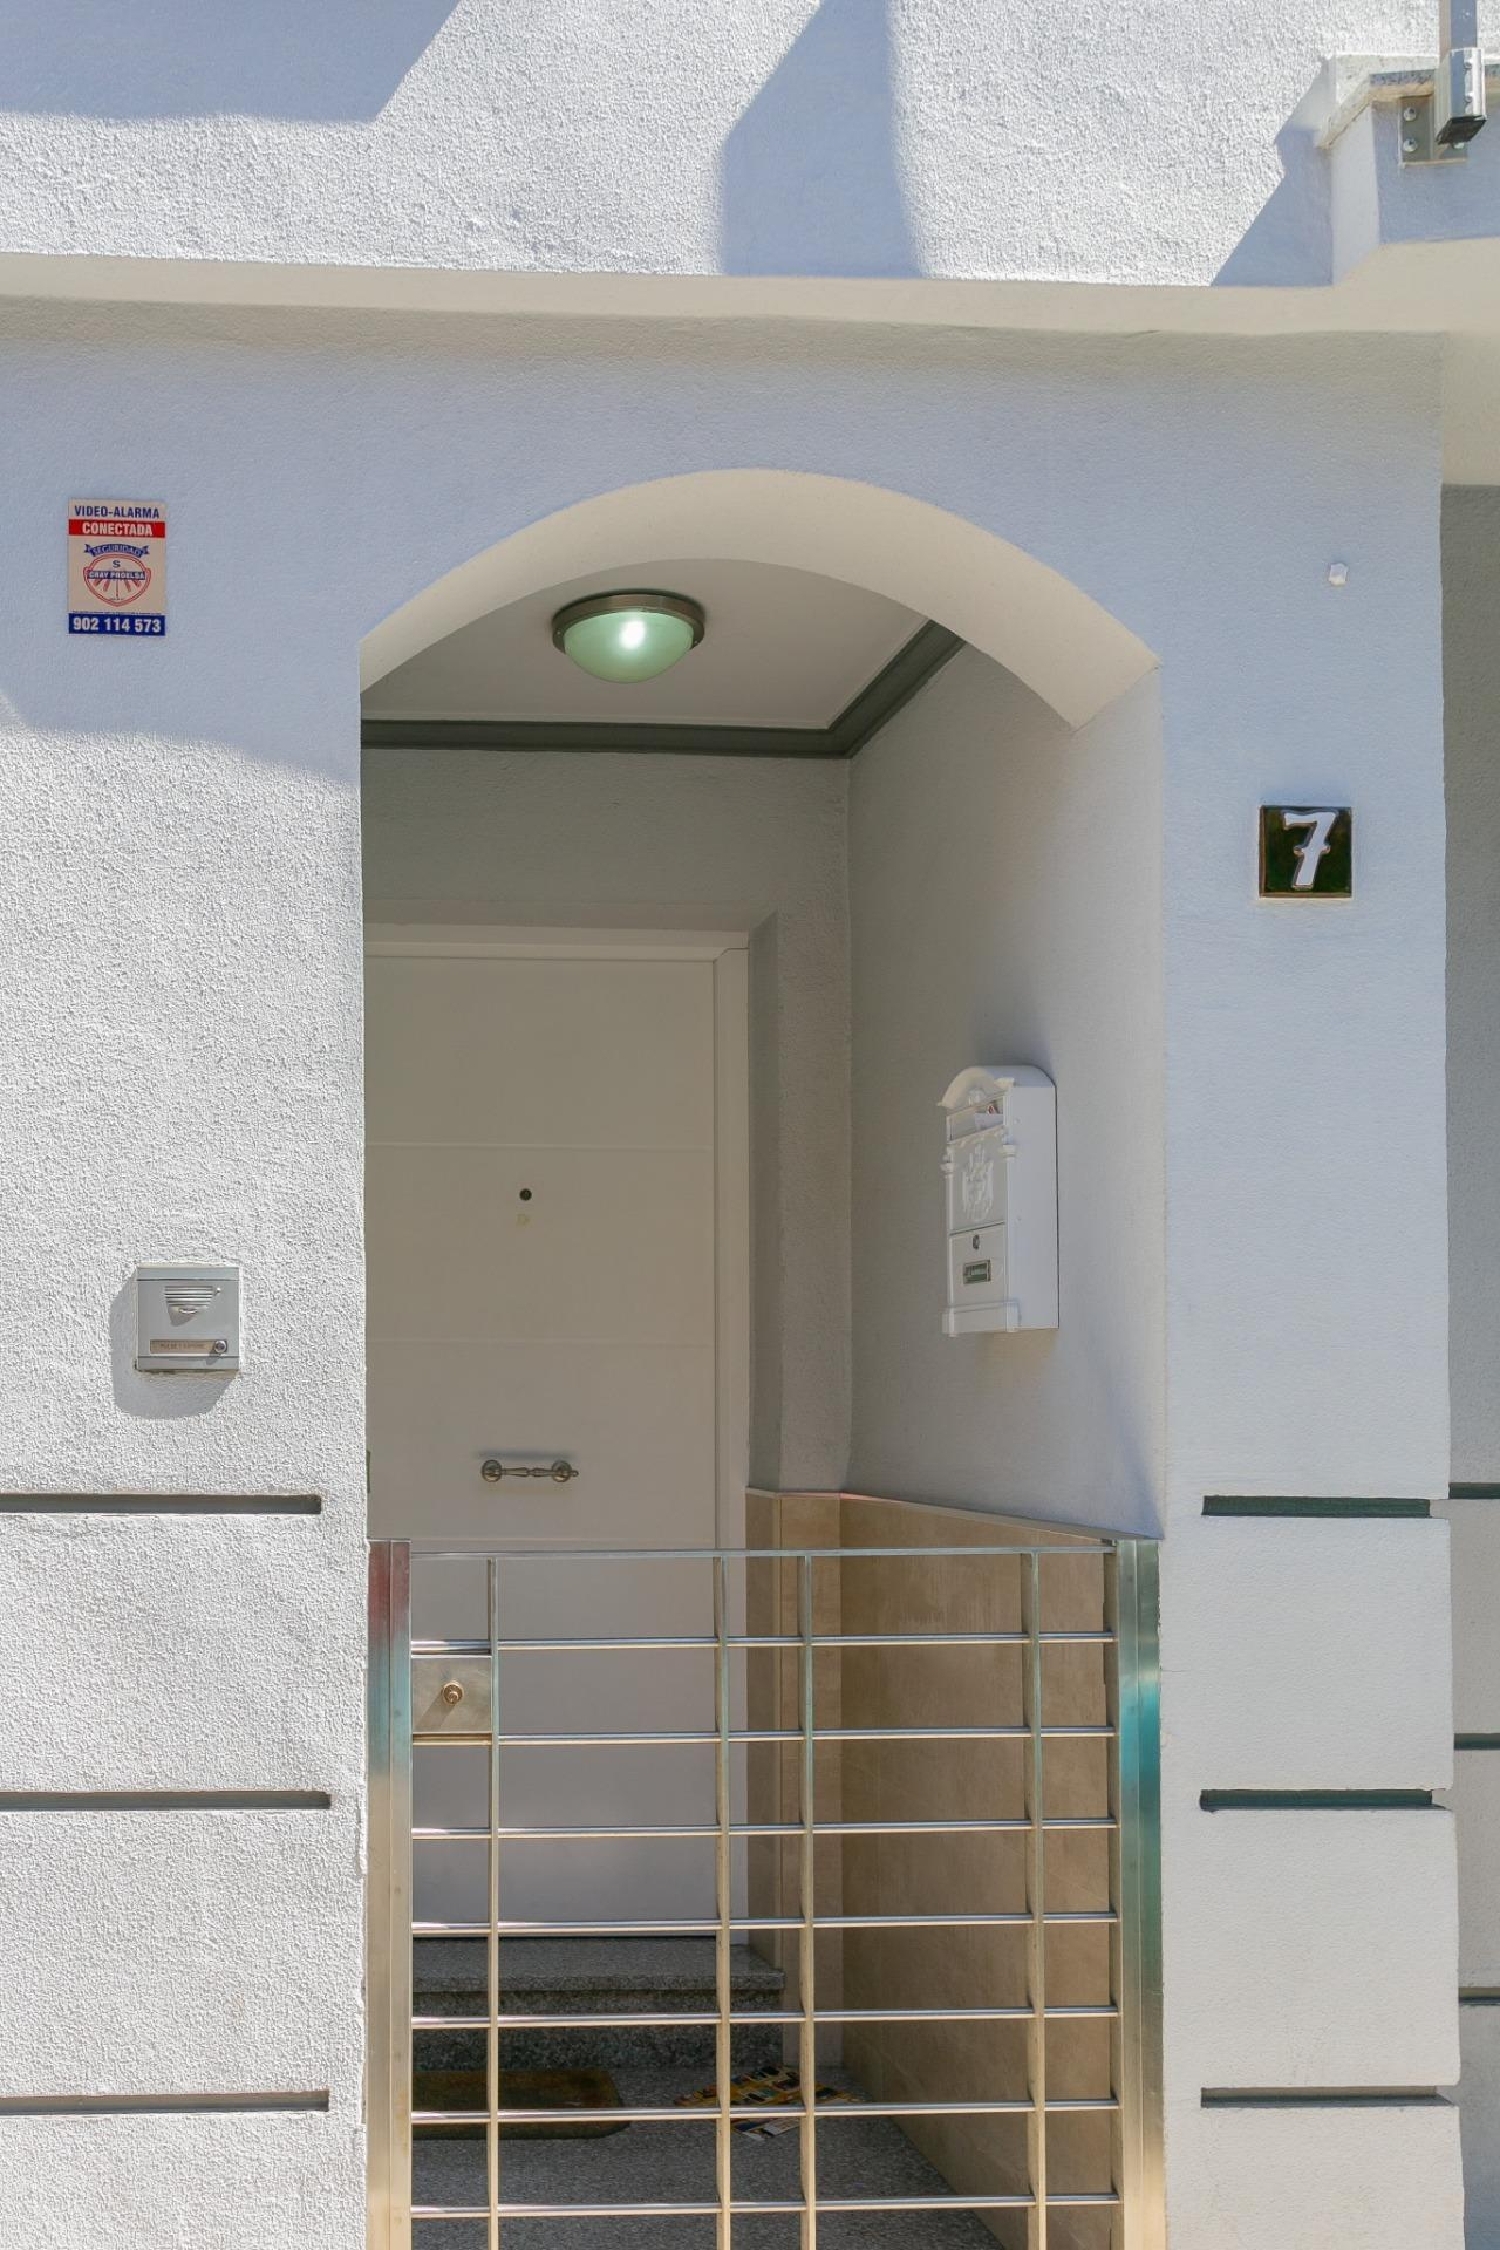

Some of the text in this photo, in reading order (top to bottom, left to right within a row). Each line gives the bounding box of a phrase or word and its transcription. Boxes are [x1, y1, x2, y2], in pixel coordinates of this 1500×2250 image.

[74, 505, 160, 519] VIDEO-ALARMA
[82, 522, 153, 536] CONECTADA
[73, 617, 162, 633] 902 114 573
[1282, 809, 1338, 890] 7
